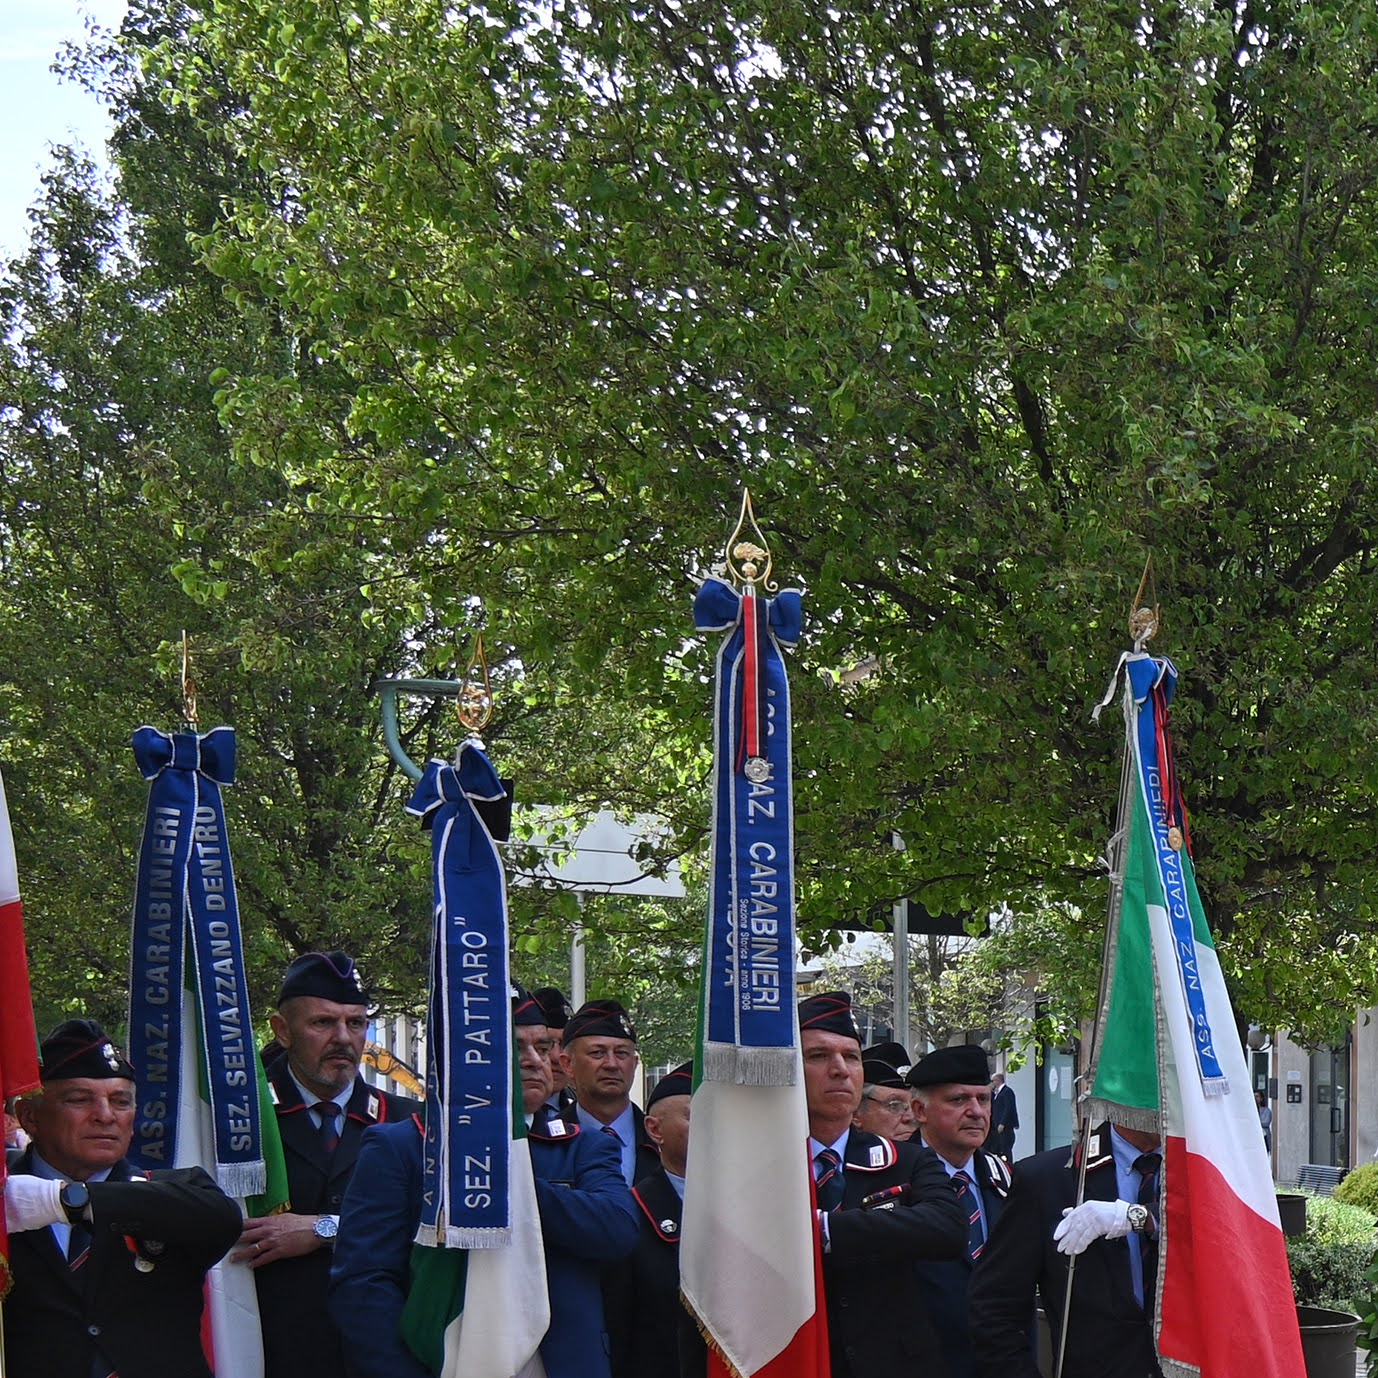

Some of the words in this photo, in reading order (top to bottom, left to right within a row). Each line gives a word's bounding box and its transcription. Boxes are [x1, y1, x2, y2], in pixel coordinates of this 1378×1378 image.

[747, 762, 775, 825] AZ.
[195, 805, 228, 912] DENTRO
[144, 806, 182, 1005] CARABINIERI
[749, 841, 781, 1012] CARABINIERI
[741, 969, 751, 989] anno
[1180, 935, 1200, 990] NAZ.
[208, 920, 249, 1089] SELVAZZANO
[145, 1012, 170, 1082] NAZ.
[140, 1089, 169, 1161] ASS.
[229, 1094, 252, 1152] SEZ.
[464, 1146, 491, 1209] SEZ.
